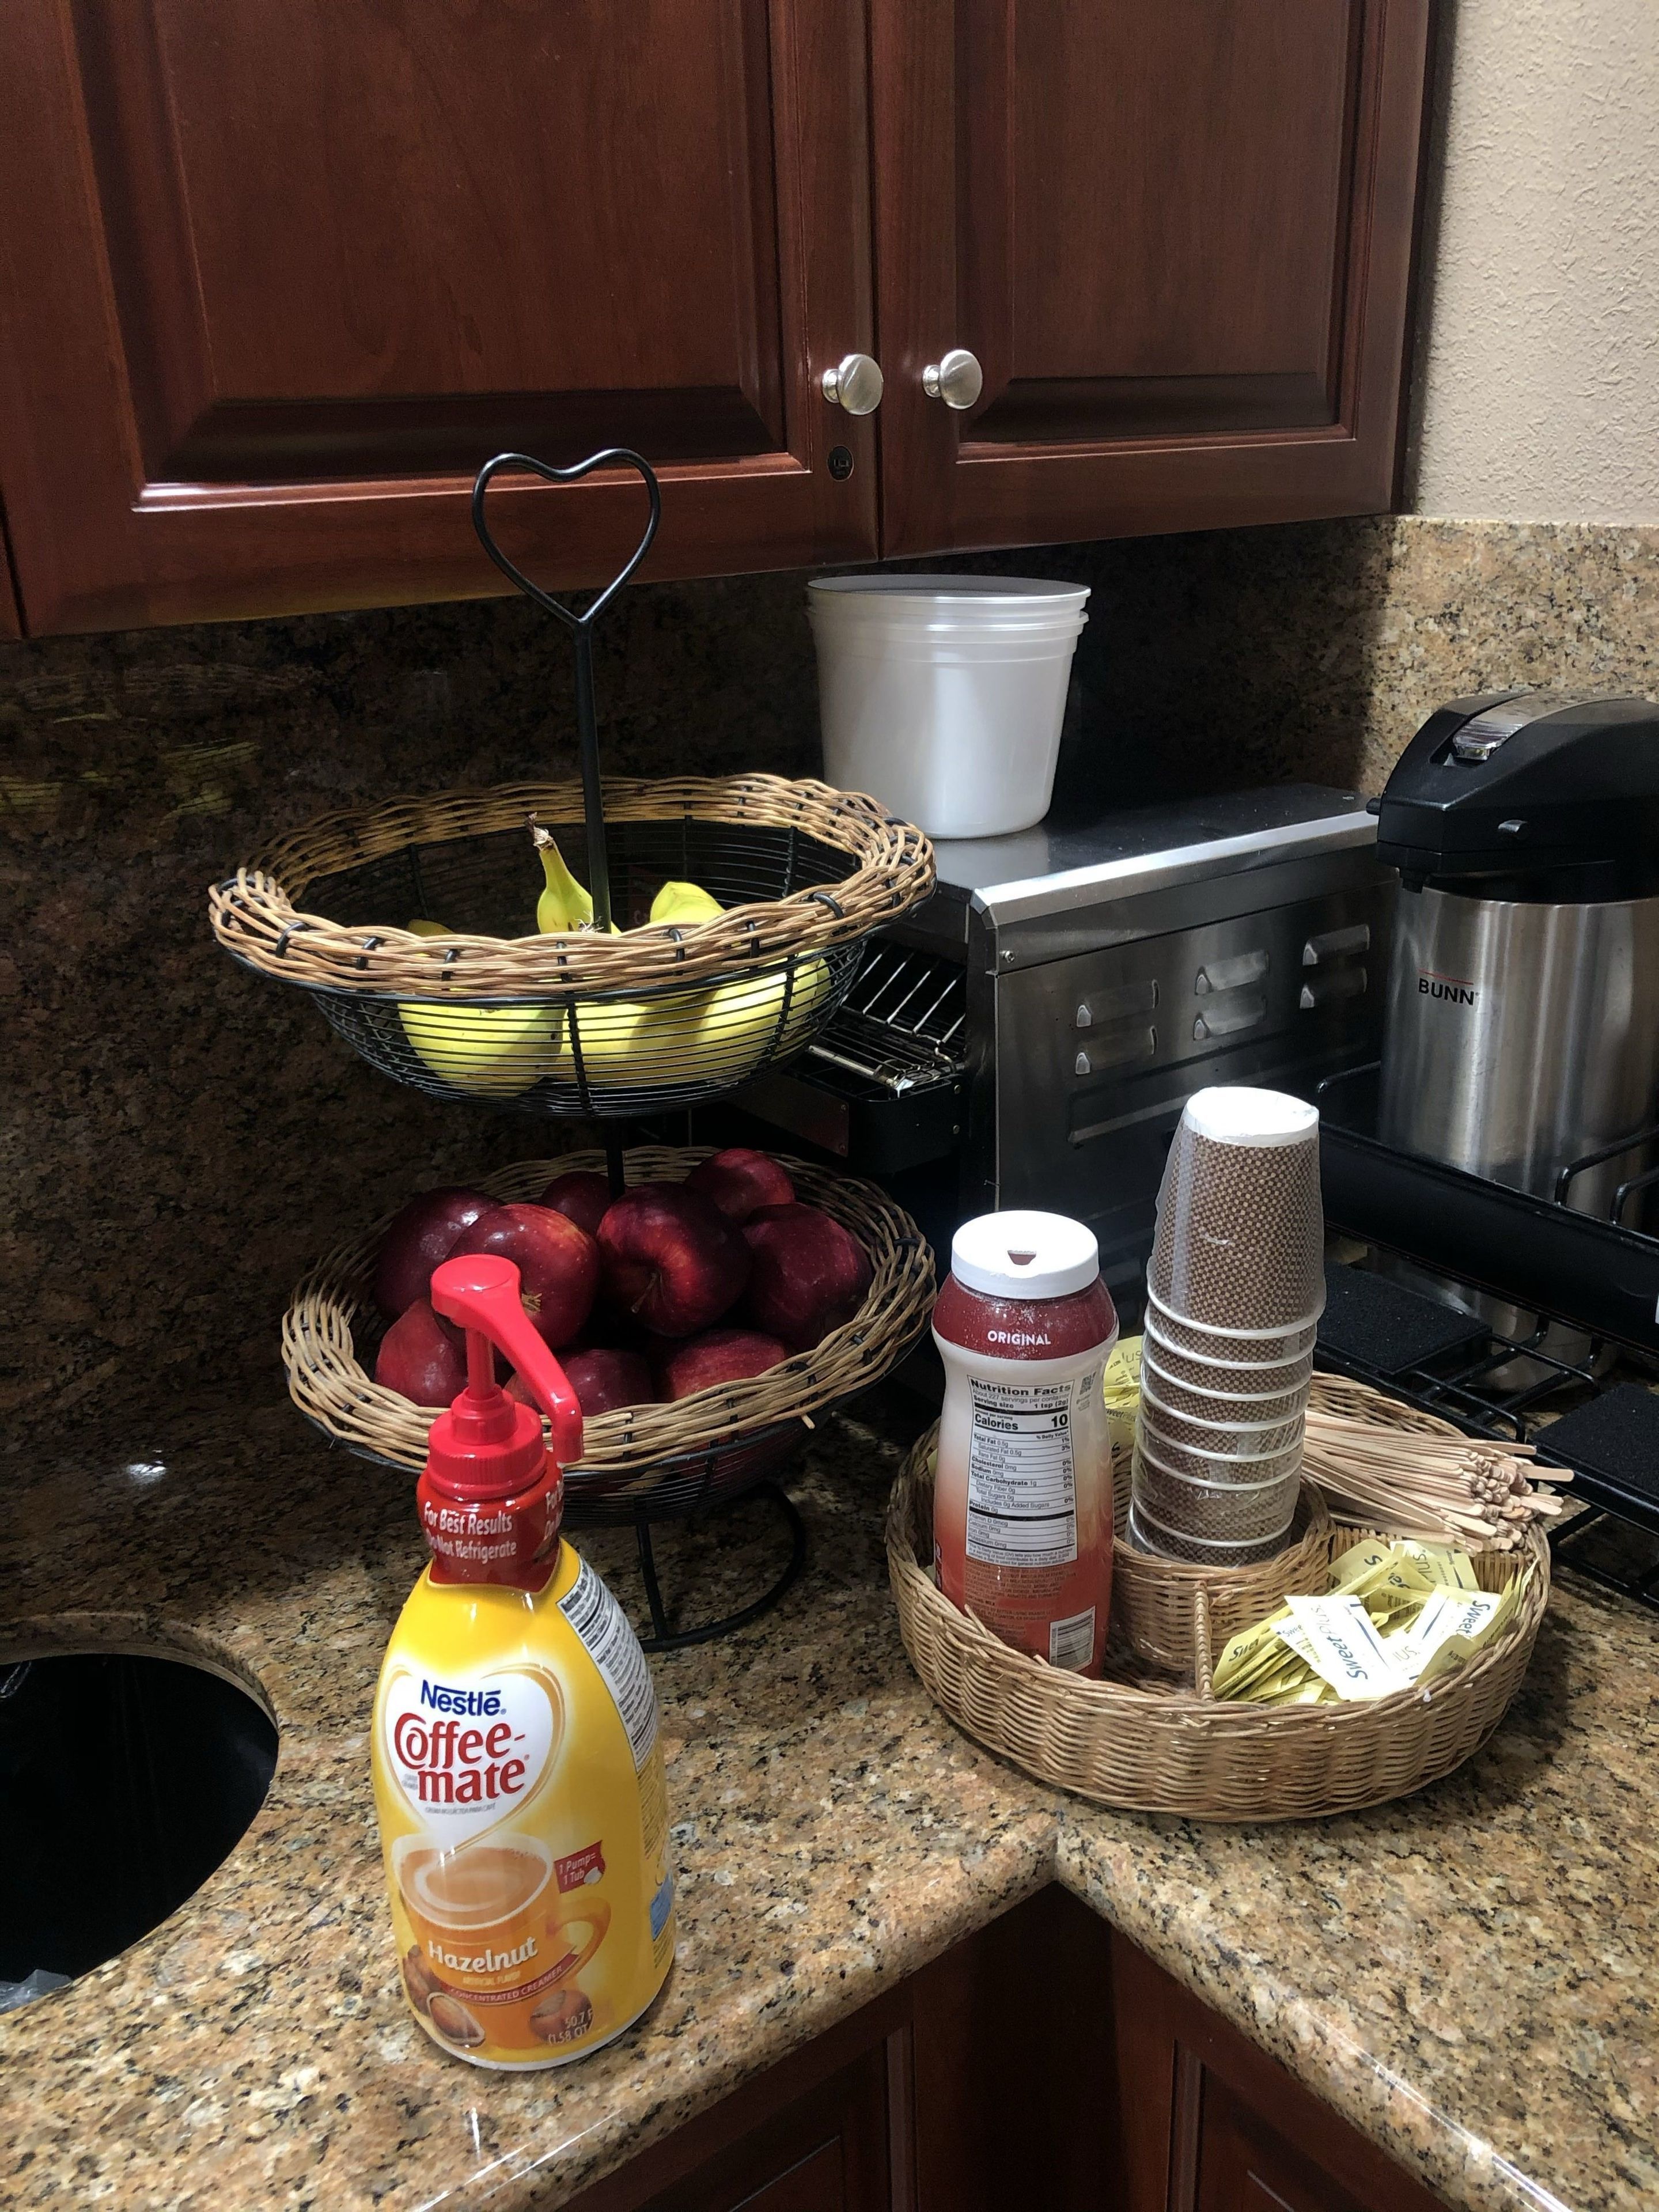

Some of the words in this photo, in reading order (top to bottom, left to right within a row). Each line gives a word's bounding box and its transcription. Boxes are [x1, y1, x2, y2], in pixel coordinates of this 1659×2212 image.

[1418, 978, 1475, 1006] BUNN
[987, 1330, 1051, 1346] ORIGINAL
[971, 1379, 1028, 1395] Nutrition
[1034, 1384, 1071, 1395] Facts
[973, 1389, 987, 1398] About
[1001, 1396, 1027, 1404] servings
[1041, 1393, 1069, 1402] container
[974, 1395, 997, 1407] Serving
[1055, 1398, 1068, 1407] (2g)
[975, 1413, 1018, 1430] Calories
[1051, 1414, 1067, 1427] 10
[974, 1434, 986, 1442] Total
[979, 1442, 999, 1453] Saturated
[971, 1464, 991, 1474] Sodium
[972, 1456, 1003, 1468] Cholesterol
[971, 1471, 984, 1479] Total
[986, 1476, 1028, 1486] Carbohydrate
[976, 1480, 993, 1490] Dietary
[976, 1487, 987, 1495] Total
[988, 1491, 1006, 1499] Sugars
[969, 1500, 990, 1511] Protein
[981, 1496, 1002, 1506] Includes
[424, 1501, 438, 1527] For
[440, 1509, 466, 1535] Best
[468, 1510, 513, 1535] Results
[969, 1512, 986, 1522] Vitamin
[993, 1518, 1008, 1527] 0mcg
[978, 1529, 990, 1538] 0mg
[989, 1525, 1001, 1533] 0mg
[437, 1535, 454, 1555] Not
[455, 1540, 517, 1565] Refrigerate
[421, 1679, 501, 1717] Nestlé
[394, 1712, 526, 1770] Coffee-
[417, 1759, 525, 1804] mate
[559, 1863, 563, 1875] 1
[563, 1874, 568, 1885] 1
[570, 1868, 585, 1883] Tub
[428, 1936, 538, 1974] Hazelnut
[450, 1988, 519, 2002] CONCENTRATED
[521, 1965, 563, 1995] CREAMER
